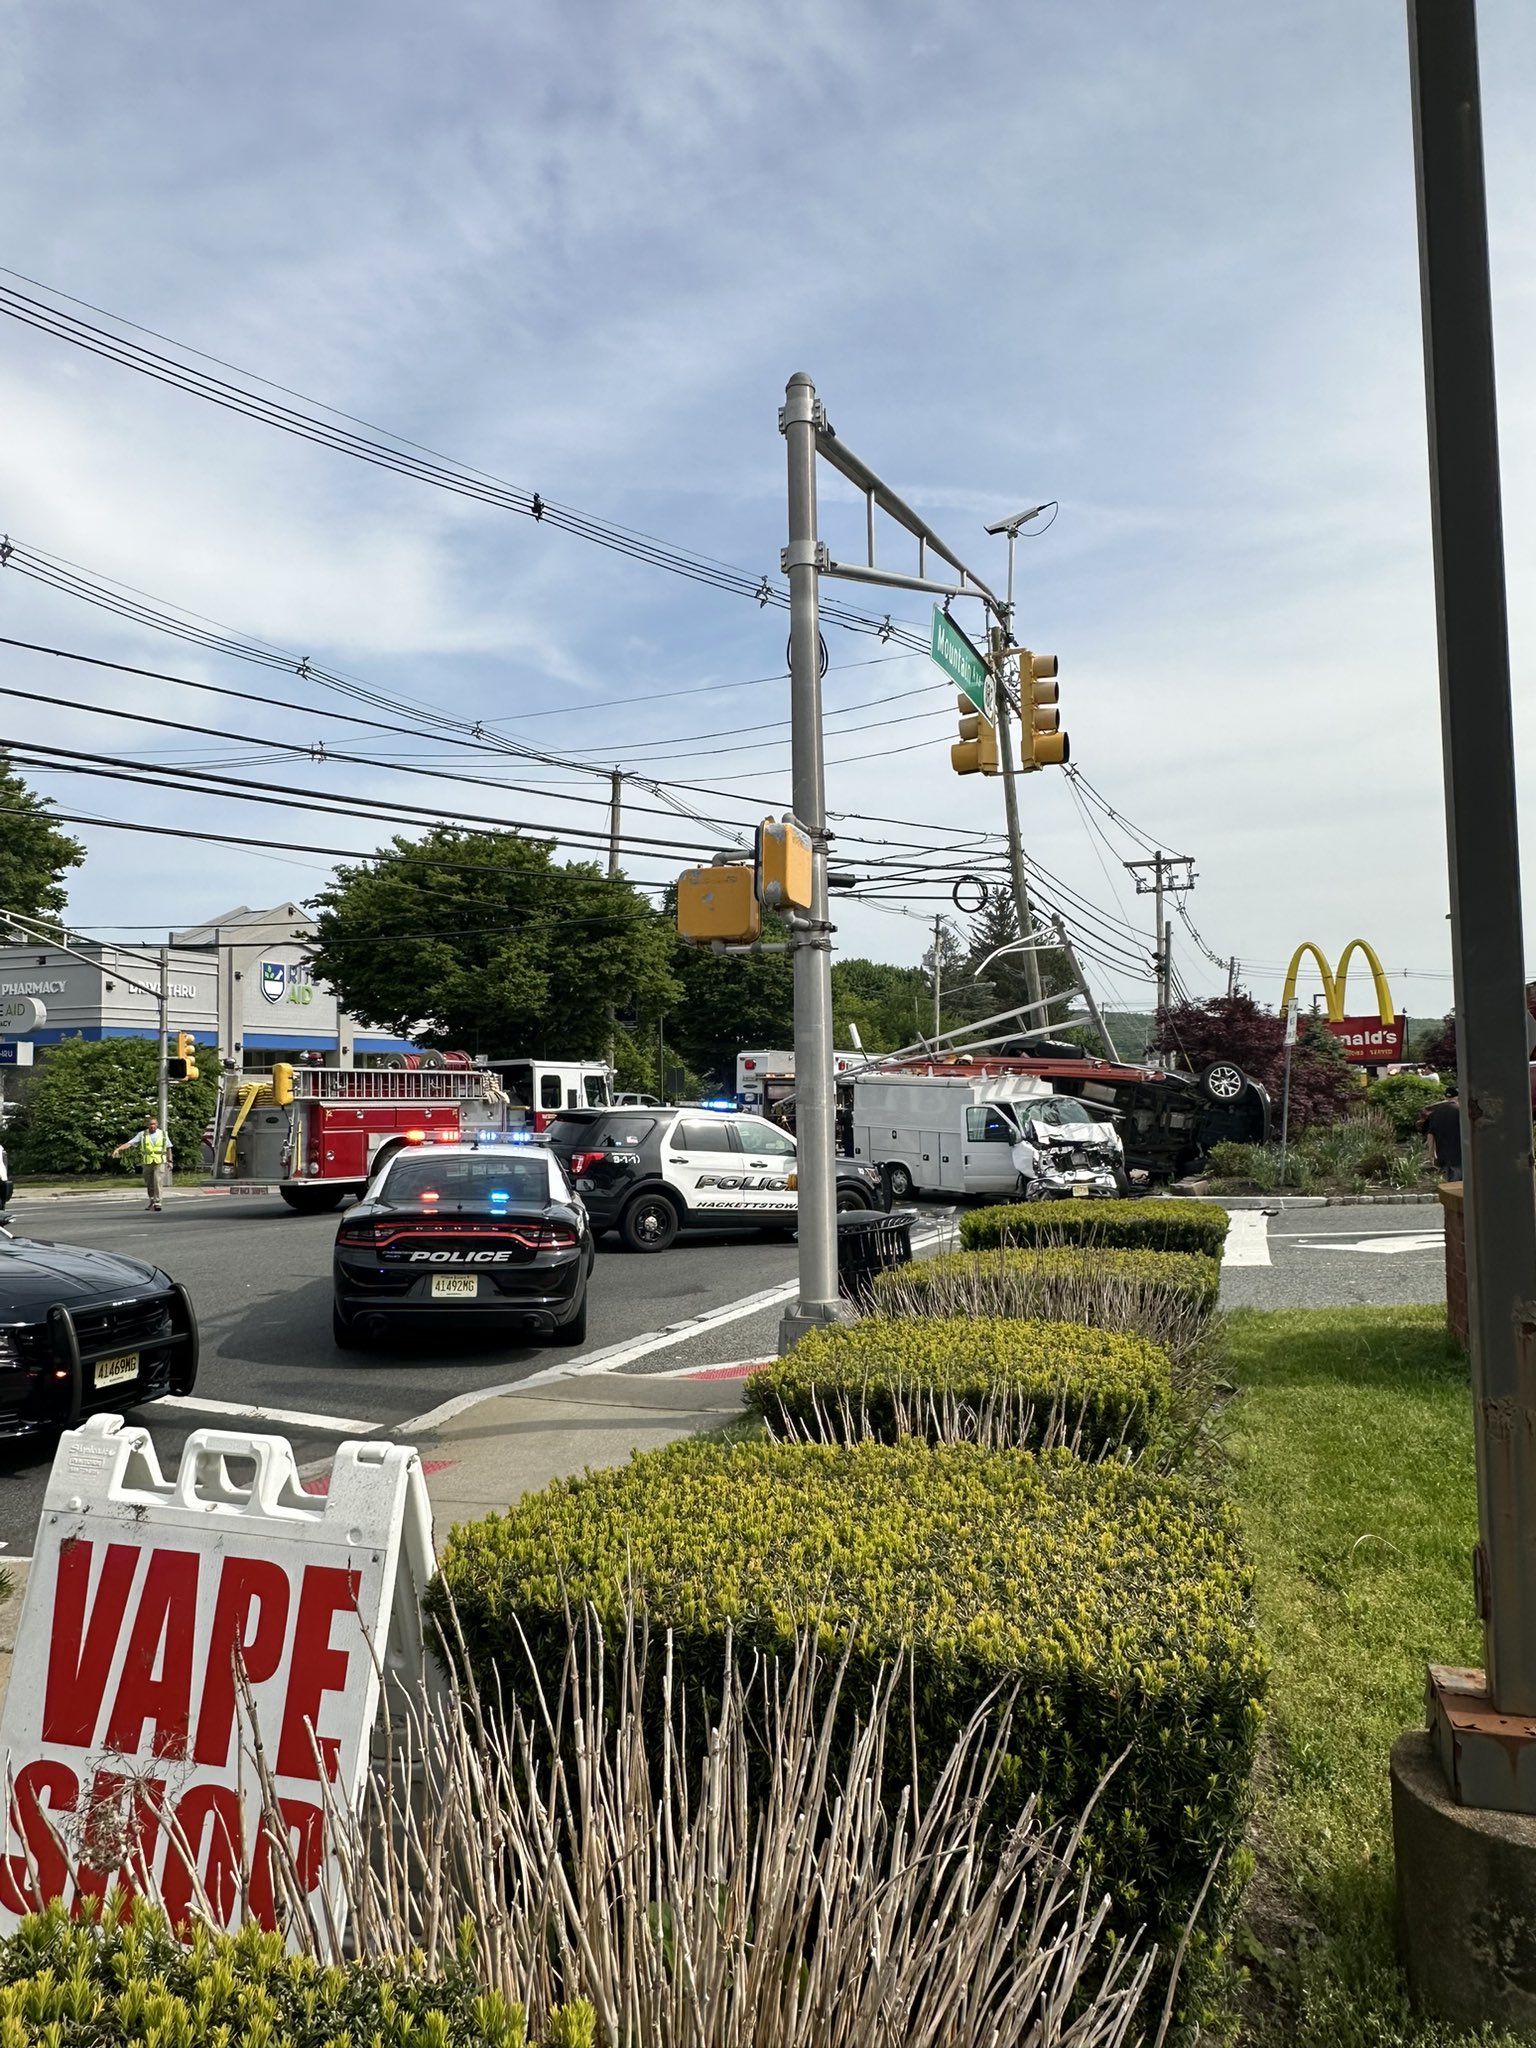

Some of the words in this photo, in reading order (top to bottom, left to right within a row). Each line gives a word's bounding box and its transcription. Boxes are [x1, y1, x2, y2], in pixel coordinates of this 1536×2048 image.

[937, 624, 972, 686] Mountain
[1, 980, 67, 996] PHARMACY
[168, 983, 197, 998] THRU
[286, 985, 313, 1005] AID
[5, 1003, 26, 1016] AID
[1335, 1030, 1398, 1046] nald's
[694, 1174, 798, 1192] POLIC
[409, 1251, 513, 1262] POLICE
[434, 1279, 475, 1292] 41492MG
[97, 1356, 137, 1379] 41469MG
[41, 1537, 362, 1784] VAPE
